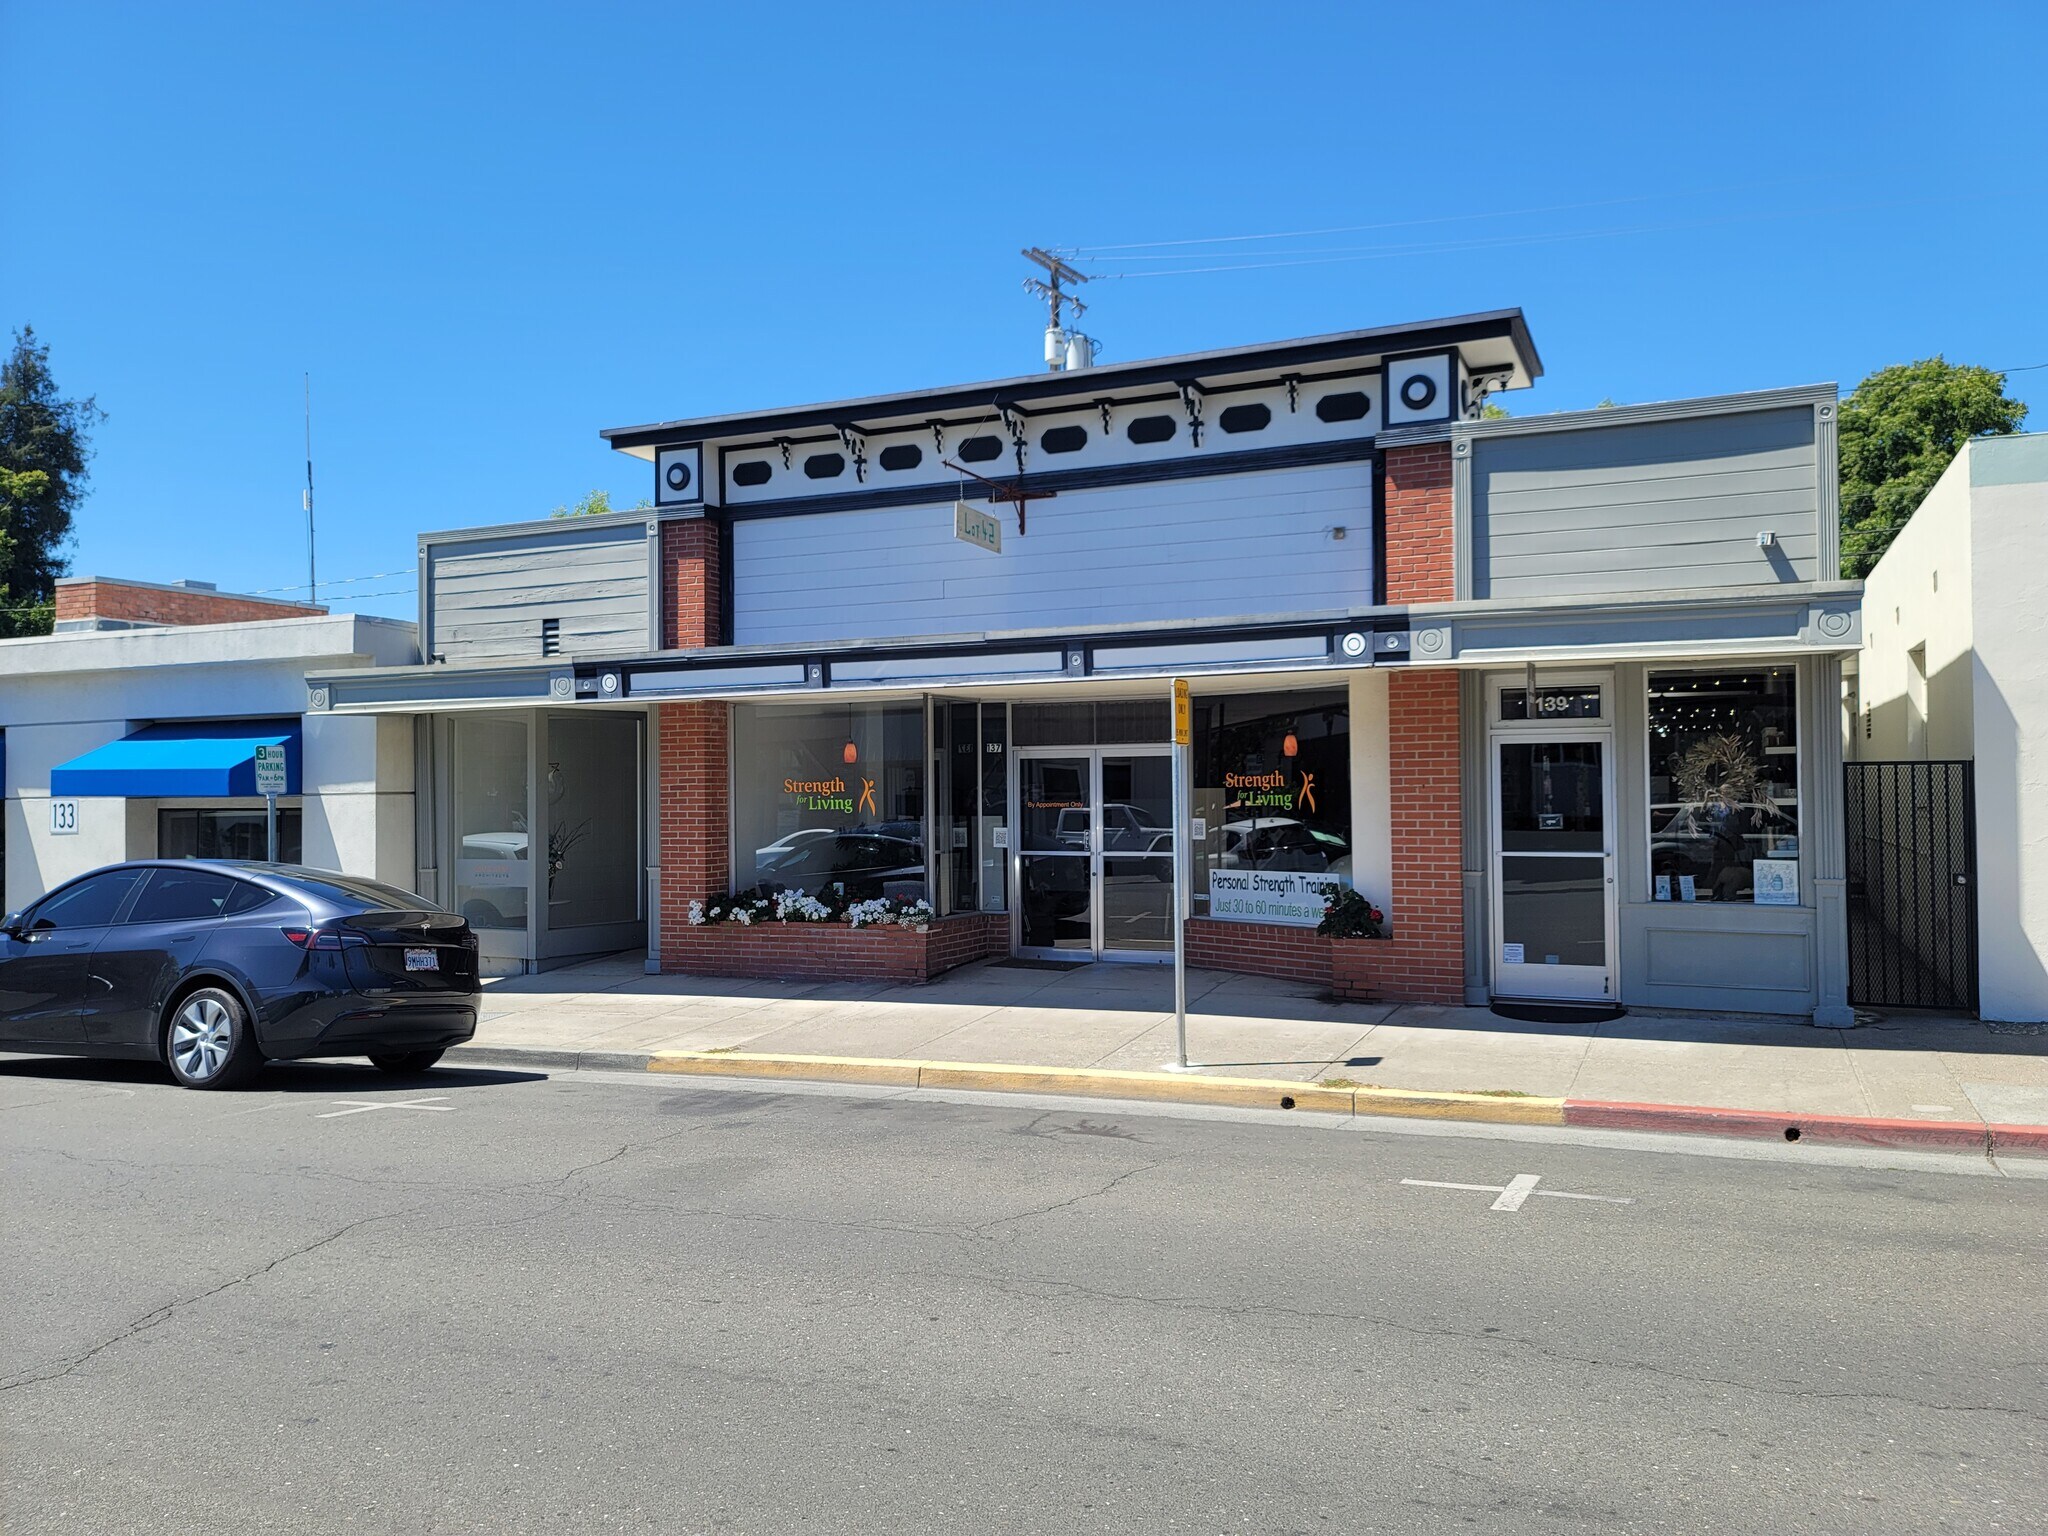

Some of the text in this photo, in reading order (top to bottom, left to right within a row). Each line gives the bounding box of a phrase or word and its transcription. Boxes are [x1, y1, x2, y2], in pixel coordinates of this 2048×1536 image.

[982, 520, 995, 544] 42
[1536, 696, 1568, 712] 139
[258, 747, 266, 759] 3
[987, 743, 1001, 752] 137
[258, 762, 284, 771] PARKING
[783, 776, 845, 796] Strength
[1225, 770, 1285, 791] Strength
[796, 795, 853, 814] for Living
[1237, 790, 1293, 811] for Living
[53, 803, 75, 828] 133
[1212, 871, 1249, 890] Personal
[1252, 874, 1295, 897] Strength
[1215, 898, 1232, 913] Just
[1233, 899, 1243, 913] 30
[1245, 900, 1253, 914] to
[1255, 900, 1266, 915] 60
[1268, 901, 1302, 917] minutes
[1303, 906, 1310, 918] a
[407, 956, 436, 967] 9MHH371
